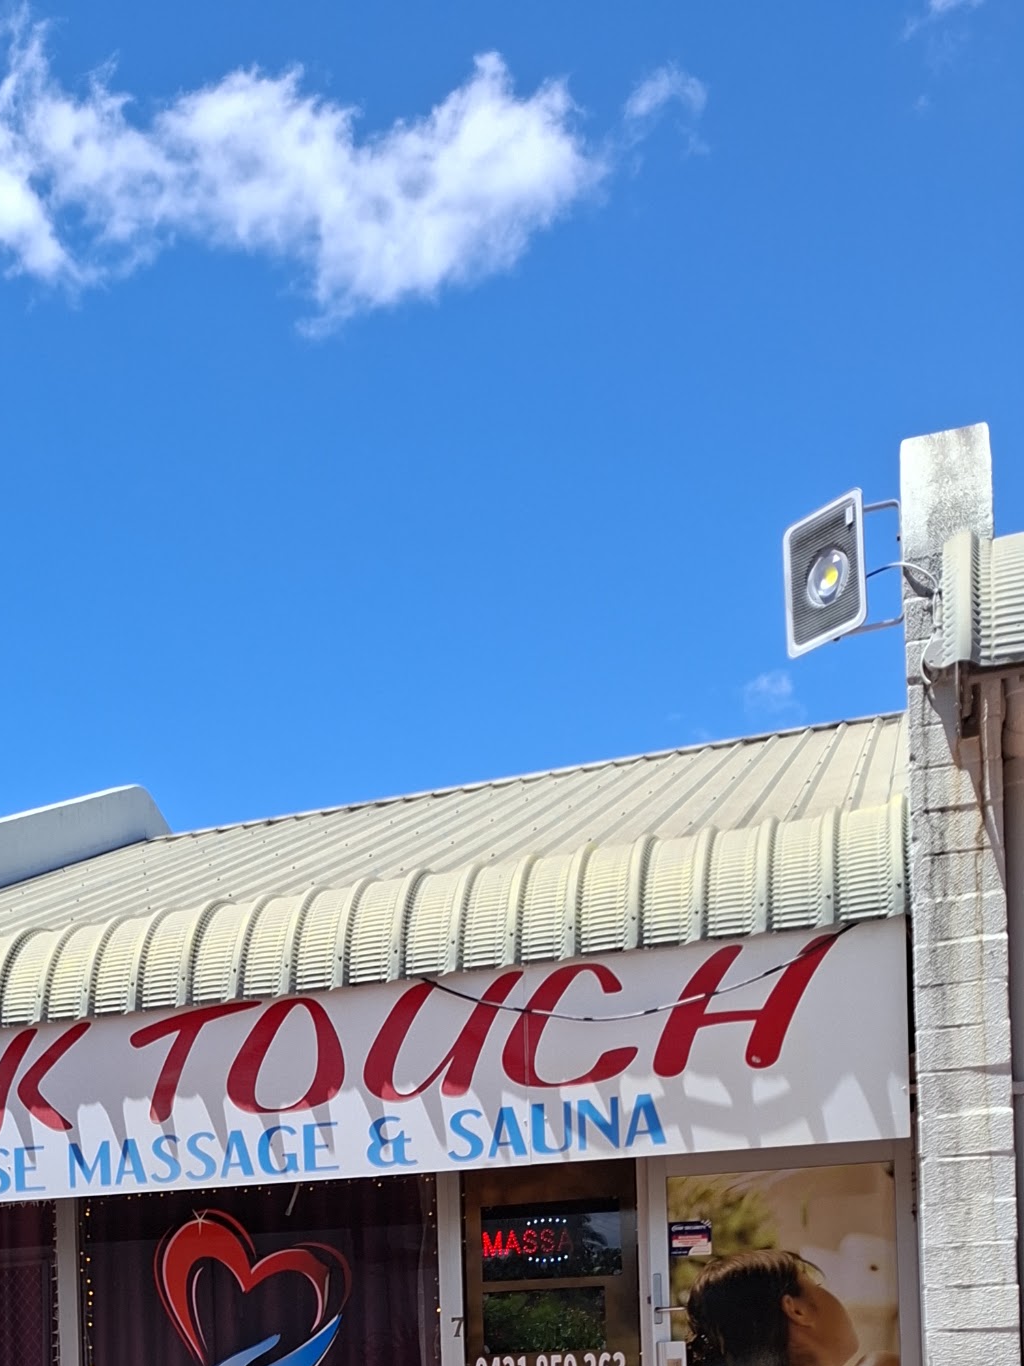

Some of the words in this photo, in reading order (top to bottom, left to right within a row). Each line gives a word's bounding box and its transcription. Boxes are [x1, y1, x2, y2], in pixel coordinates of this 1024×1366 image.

[129, 933, 841, 1125] TOUCH
[68, 1121, 340, 1190] MASSAGE
[366, 1116, 418, 1169] &
[448, 1093, 667, 1163] SAUNA
[451, 1317, 464, 1338] 7
